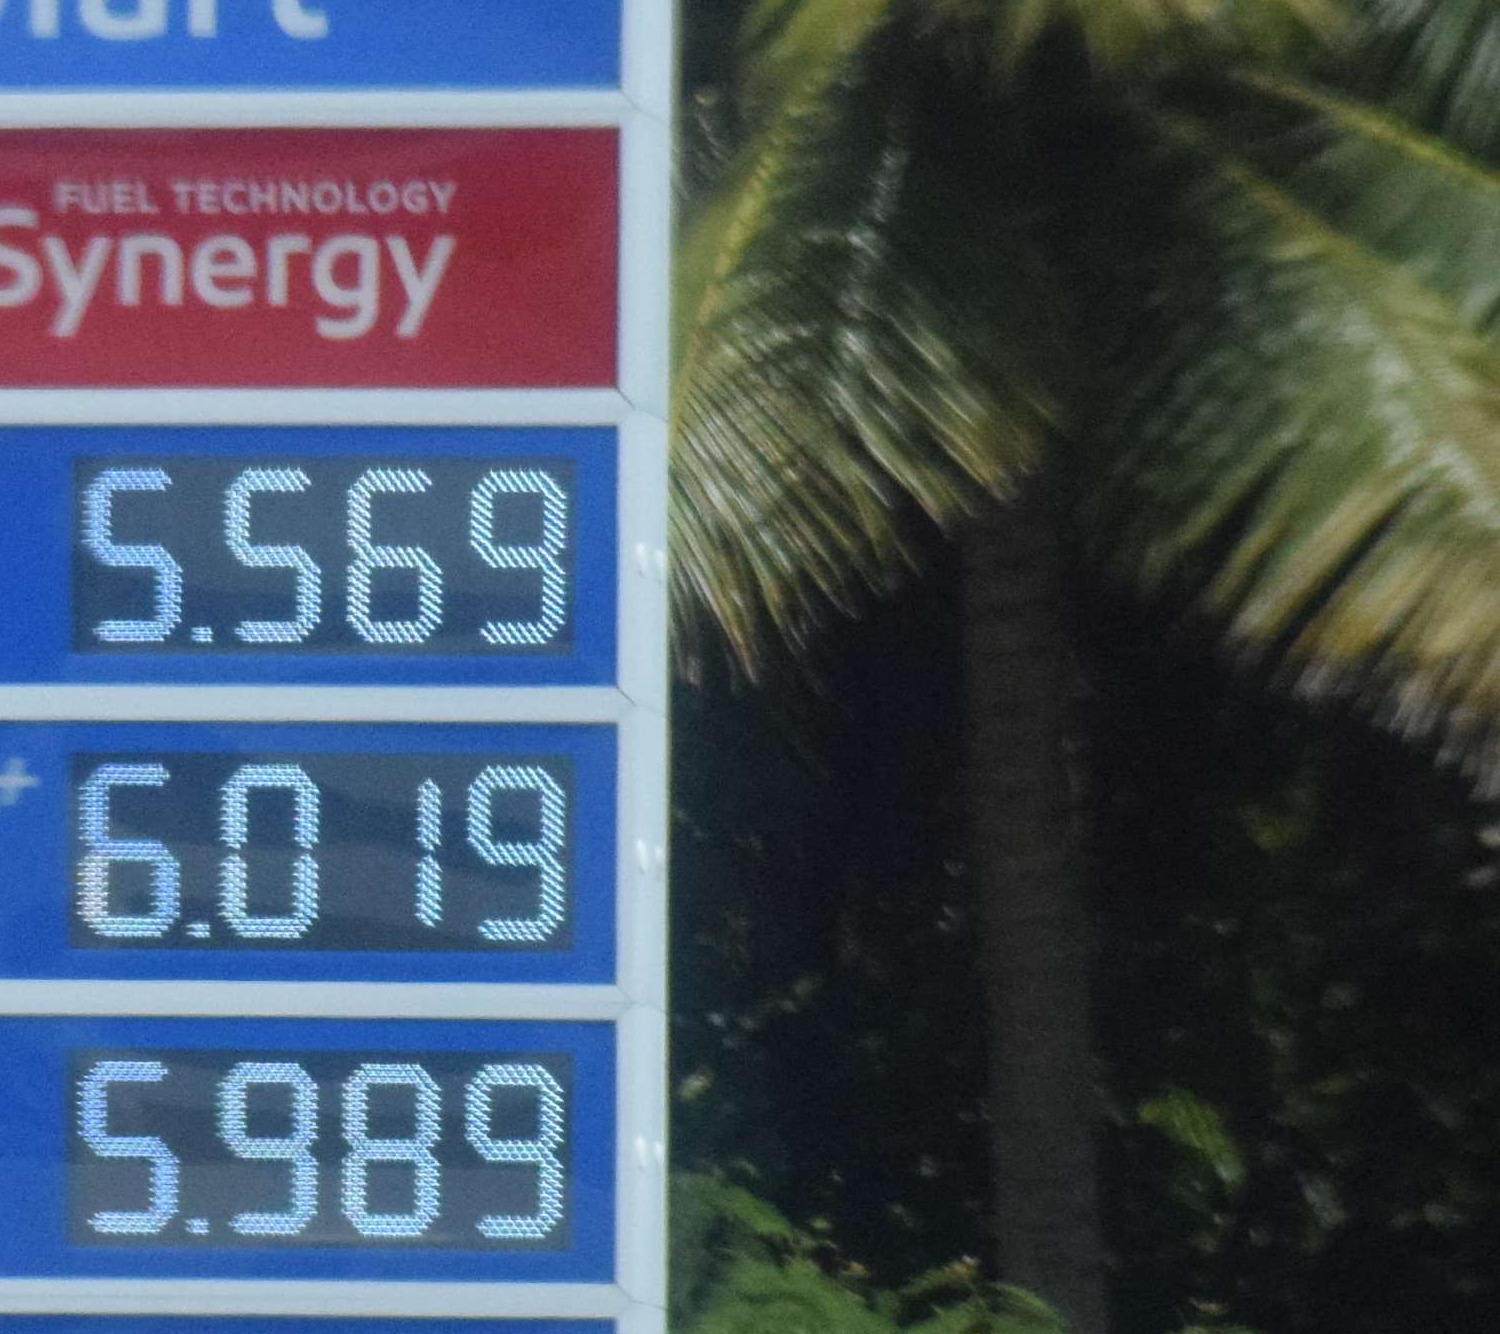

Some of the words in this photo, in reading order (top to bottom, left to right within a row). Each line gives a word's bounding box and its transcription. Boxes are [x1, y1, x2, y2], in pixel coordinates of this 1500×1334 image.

[53, 180, 154, 215] FUEL
[172, 180, 457, 216] TECHNOLOGY
[80, 467, 567, 646] 5.569
[76, 763, 567, 941] 6.019
[75, 1060, 566, 1240] 5.989
